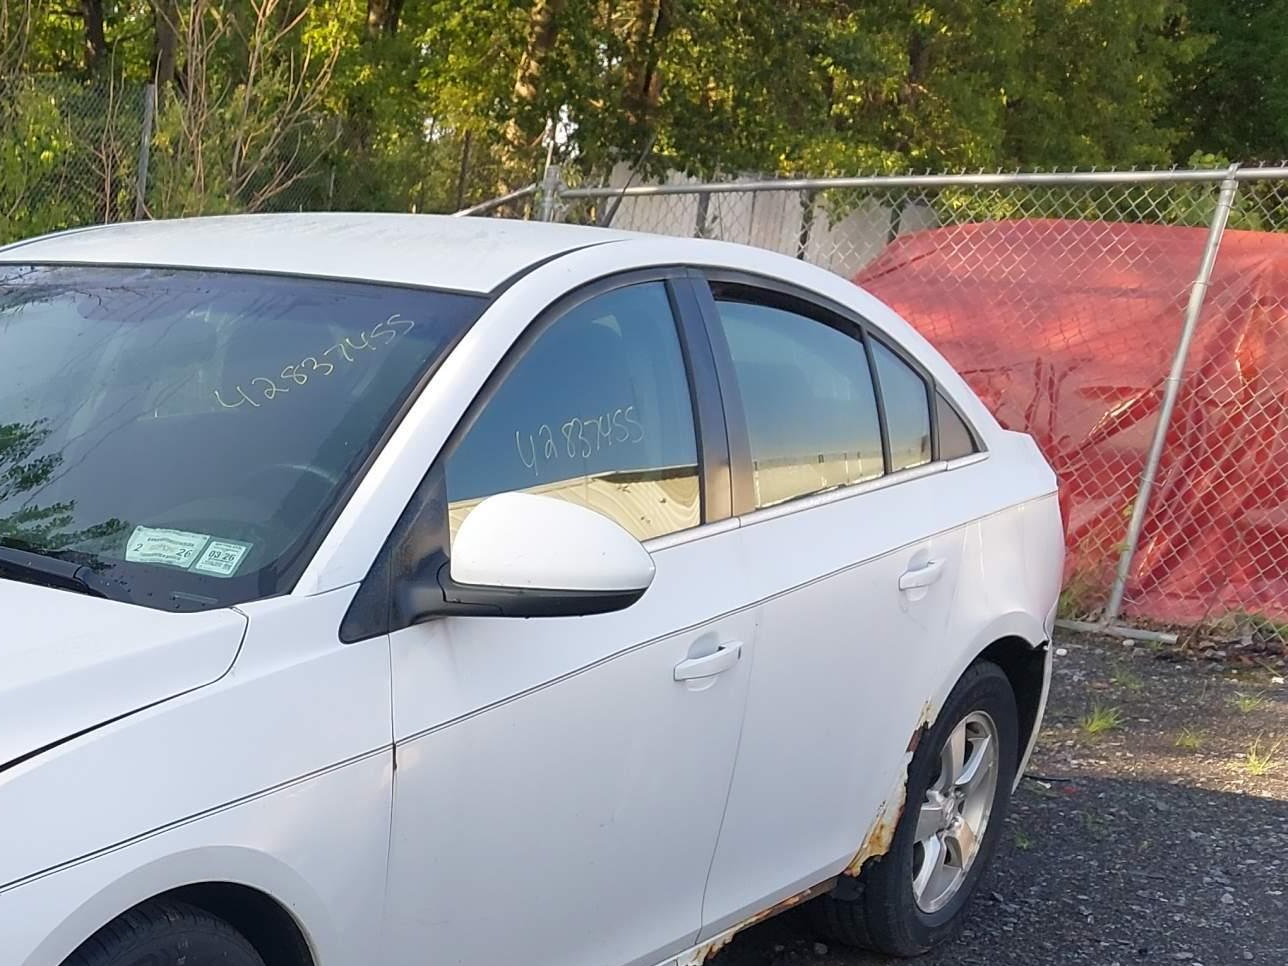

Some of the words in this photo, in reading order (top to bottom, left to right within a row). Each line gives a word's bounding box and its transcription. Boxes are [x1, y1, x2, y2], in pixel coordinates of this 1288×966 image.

[213, 313, 416, 409] 42837455
[514, 405, 647, 477] 42837455
[175, 548, 193, 558] 26
